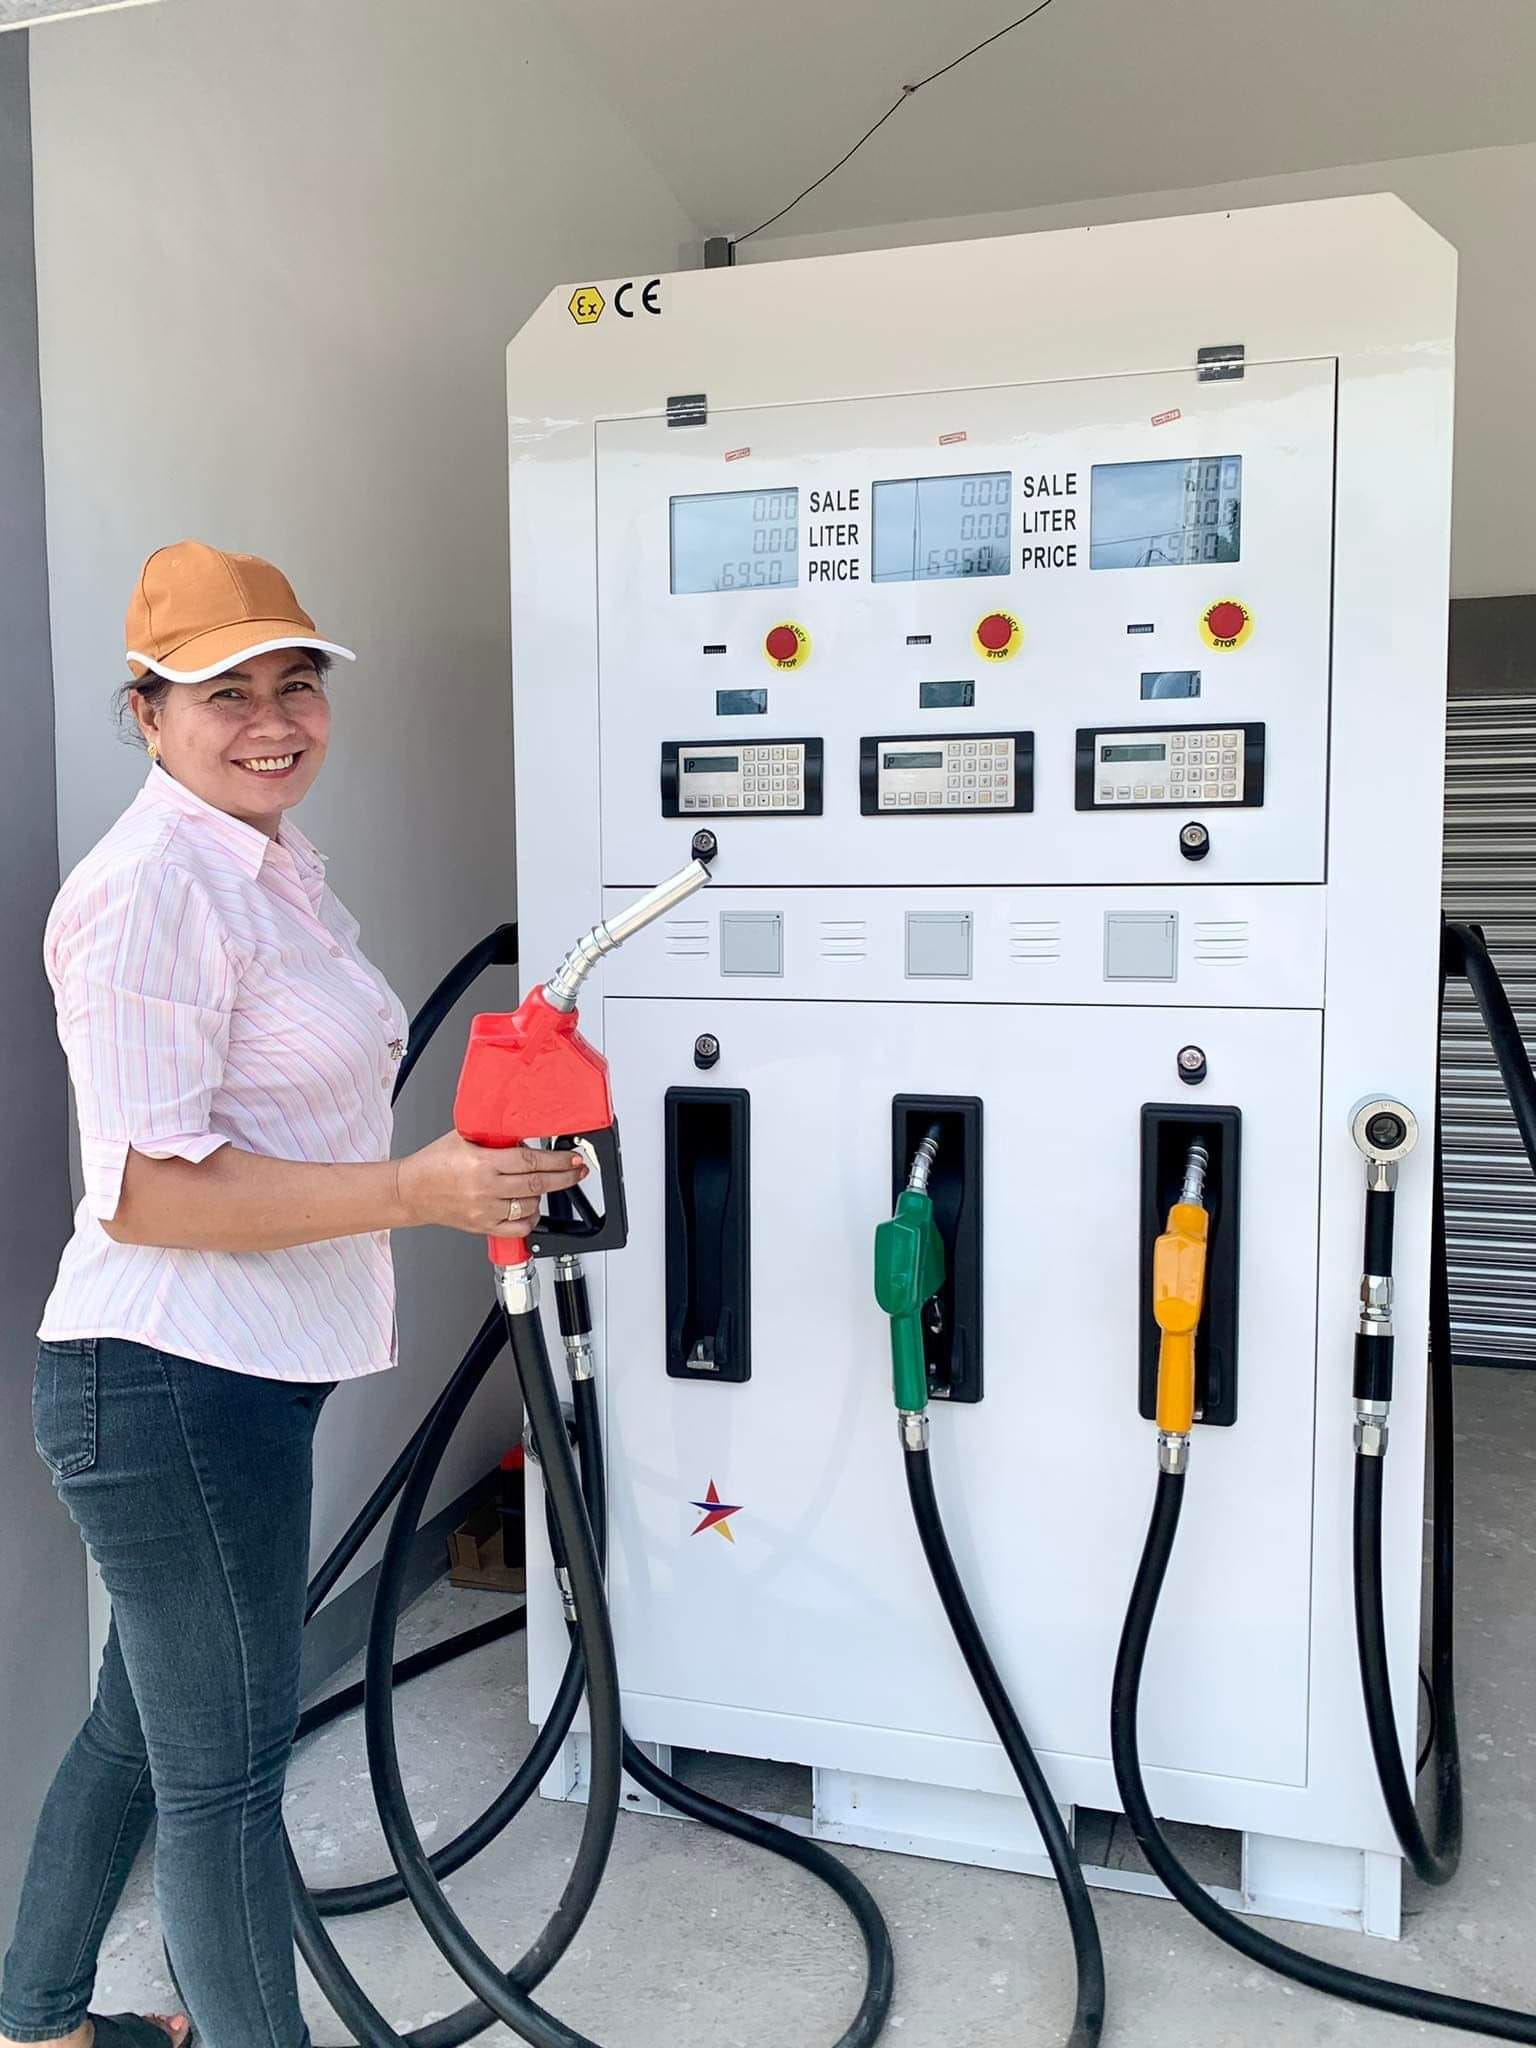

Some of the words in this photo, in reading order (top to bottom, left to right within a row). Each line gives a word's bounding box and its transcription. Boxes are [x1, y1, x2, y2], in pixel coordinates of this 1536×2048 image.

[614, 279, 661, 318] CE
[961, 479, 1009, 507] 0.00
[1023, 473, 1077, 498] SALE
[753, 495, 798, 522] 0.00
[809, 489, 860, 513] SALE
[961, 512, 1009, 541] 0.00
[1023, 509, 1077, 533] LITER
[753, 527, 798, 554] 0.00
[809, 523, 859, 547] LITER
[1022, 545, 1077, 569] PRICE
[808, 559, 860, 583] PRICE
[986, 648, 1009, 660] STOP
[1213, 638, 1237, 648] STOP
[777, 658, 797, 669] STOP
